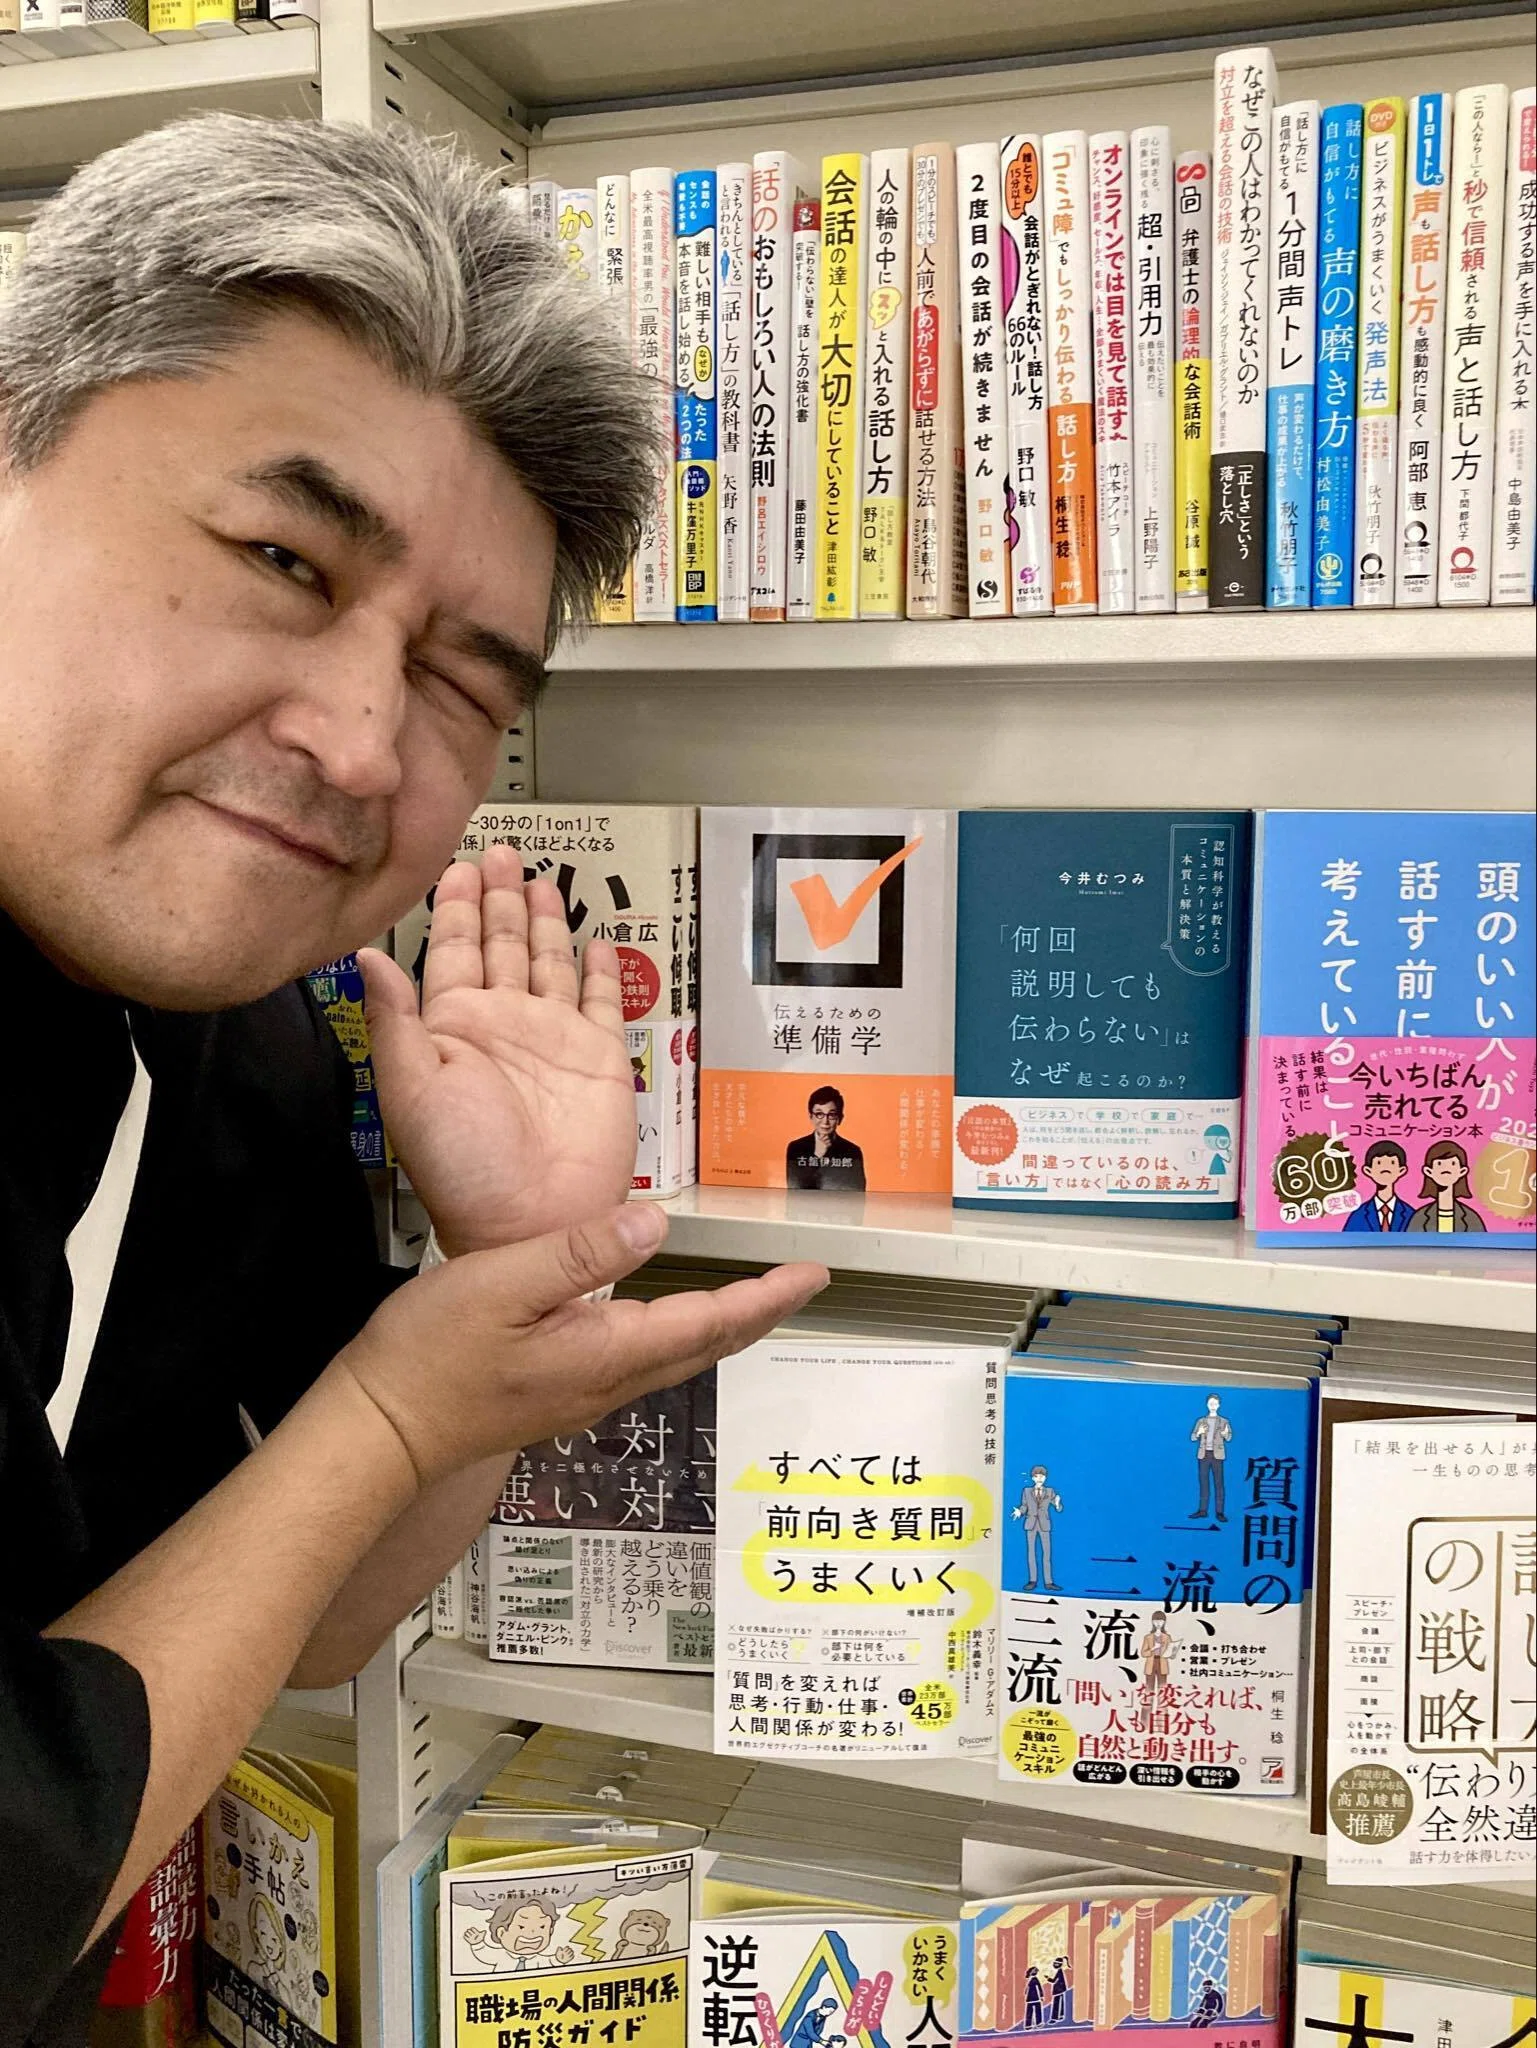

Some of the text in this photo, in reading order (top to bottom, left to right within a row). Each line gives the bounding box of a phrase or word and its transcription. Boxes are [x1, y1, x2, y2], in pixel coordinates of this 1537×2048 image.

[1295, 110, 1309, 174] 「話し方」に
[1369, 111, 1393, 124] DVD
[1022, 152, 1033, 195] 誰とでも
[1216, 66, 1237, 245] 対立を超える会話の技術
[1278, 115, 1291, 190] 自信がもてる
[1322, 121, 1341, 244] 自信がもてる
[1344, 118, 1362, 201] 話し方に
[604, 183, 616, 236] どんなに
[689, 181, 698, 220] センスも
[720, 185, 731, 248] と言われる
[1009, 167, 1022, 211] 15分以上
[731, 178, 745, 287] 「きちんとしている」
[1236, 65, 1265, 405] なぜこの人はわかってくれないのか
[695, 240, 712, 343] 難しい相手も
[803, 240, 817, 319] 「伝わらない」壁を
[1136, 212, 1163, 337] 超・引用力
[1276, 191, 1307, 370] 1分間声トレ
[678, 242, 691, 384] 本音を話し始める
[968, 173, 994, 478] 2度目の会話が続きません
[1023, 215, 1044, 411] 会話がとぎれない!話し方
[1181, 229, 1202, 440] 弁護士の論理的な会話術
[698, 349, 708, 378] なぜか
[721, 292, 742, 454] 「話し方」の教科書
[795, 323, 812, 423] 話し方の強化書
[820, 168, 858, 536] 会話の達人が大切にしていること
[915, 248, 938, 508] 人前であがらずに話せる方法
[1007, 316, 1026, 397] 66のルール
[1316, 246, 1358, 451] 声の磨き方
[695, 404, 707, 442] たった
[1106, 463, 1121, 538] 竹本アイラ
[1218, 465, 1235, 525] 落とし穴
[1236, 465, 1254, 560] 「正しさ」という
[1315, 456, 1333, 552] 村松由美子
[1505, 477, 1523, 551] 中島由美子
[686, 502, 698, 569] 牛窪万里子
[756, 496, 768, 576] 野呂エイシロウ
[794, 499, 808, 565] 藤田由美子
[1143, 506, 1159, 570] 上野陽子
[1278, 500, 1298, 575] 秋竹朋子
[1058, 871, 1146, 885] 今井むつみ
[1178, 853, 1193, 940] 本質と解決策
[1194, 837, 1208, 957] コミュニケーションの
[1210, 839, 1225, 954] 認知科学が教える
[637, 923, 660, 943] 広
[1000, 924, 1077, 954] 「何回
[1395, 860, 1441, 1038] 話す前に
[773, 1003, 882, 1021] 伝えるための
[1010, 969, 1162, 1001] 説明しても
[1319, 857, 1363, 1158] 考えていること
[1475, 861, 1522, 1112] 頭のいい人が
[773, 1024, 882, 1056] 準備学
[1008, 1014, 1190, 1047] 伝わらない」は
[1272, 1055, 1297, 1138] 決まっている
[1291, 1052, 1313, 1113] 話す前に
[1310, 1050, 1329, 1095] 結果は
[1349, 1060, 1487, 1091] 今いちばん
[1027, 1111, 1068, 1120] ビジネス
[1095, 1111, 1122, 1121] 学校
[1349, 1123, 1484, 1139] コミュニケーション本
[1363, 1092, 1469, 1121] 売れてる
[976, 1171, 1220, 1191] 「言い方」ではなく「心の読み方」
[1021, 1154, 1180, 1171] 間違っているのは、
[1276, 1148, 1351, 1200] 60
[984, 1361, 998, 1466] 質問思考の技術
[768, 1450, 923, 1485] すべては
[758, 1500, 993, 1542] 「前向き質問」で
[1243, 1456, 1301, 1615] 質問の
[579, 1537, 592, 1653] 導き出された「対立の力学」
[591, 1538, 604, 1604] 最新の研究から
[604, 1538, 617, 1628] 膨大なインタビューと
[620, 1538, 644, 1634] 越えるか?
[642, 1539, 665, 1618] どう乗り
[666, 1540, 689, 1598] 違いを
[689, 1541, 714, 1619] 価値観の
[773, 1558, 957, 1595] うまくいく
[737, 1637, 790, 1649] どうしたら
[906, 1607, 956, 1617] 増補改訂版
[1361, 1627, 1380, 1636] 会議
[1416, 1539, 1487, 1744] の戦略
[495, 1644, 545, 1657] 推薦多数!
[738, 1648, 789, 1661] うまくいく
[830, 1641, 885, 1652] 部下は何を
[830, 1652, 906, 1663] 必要としている
[1006, 1596, 1064, 1706] 三流
[727, 1669, 881, 1693] 「質問」を変えれば
[910, 1702, 943, 1721] 45
[1066, 1678, 1264, 1712] 「問い」を変えれば、
[728, 1718, 905, 1739] 人間関係が変わる!
[1018, 1743, 1061, 1754] コミュニ
[1022, 1731, 1058, 1743] 最強の
[1076, 1734, 1248, 1766] 自然と動き出す。
[1103, 1708, 1217, 1737] 人も自分も
[1013, 1752, 1066, 1766] ケーション
[1022, 1764, 1056, 1775] スキル
[1345, 1812, 1397, 1838] 推薦
[1409, 1850, 1536, 1866] 話す力を体得したい
[911, 1936, 928, 1998] いかない
[934, 1935, 948, 1981] うまく
[465, 1972, 680, 2024] 職場の人間関係
[701, 1934, 759, 2047] 逆転
